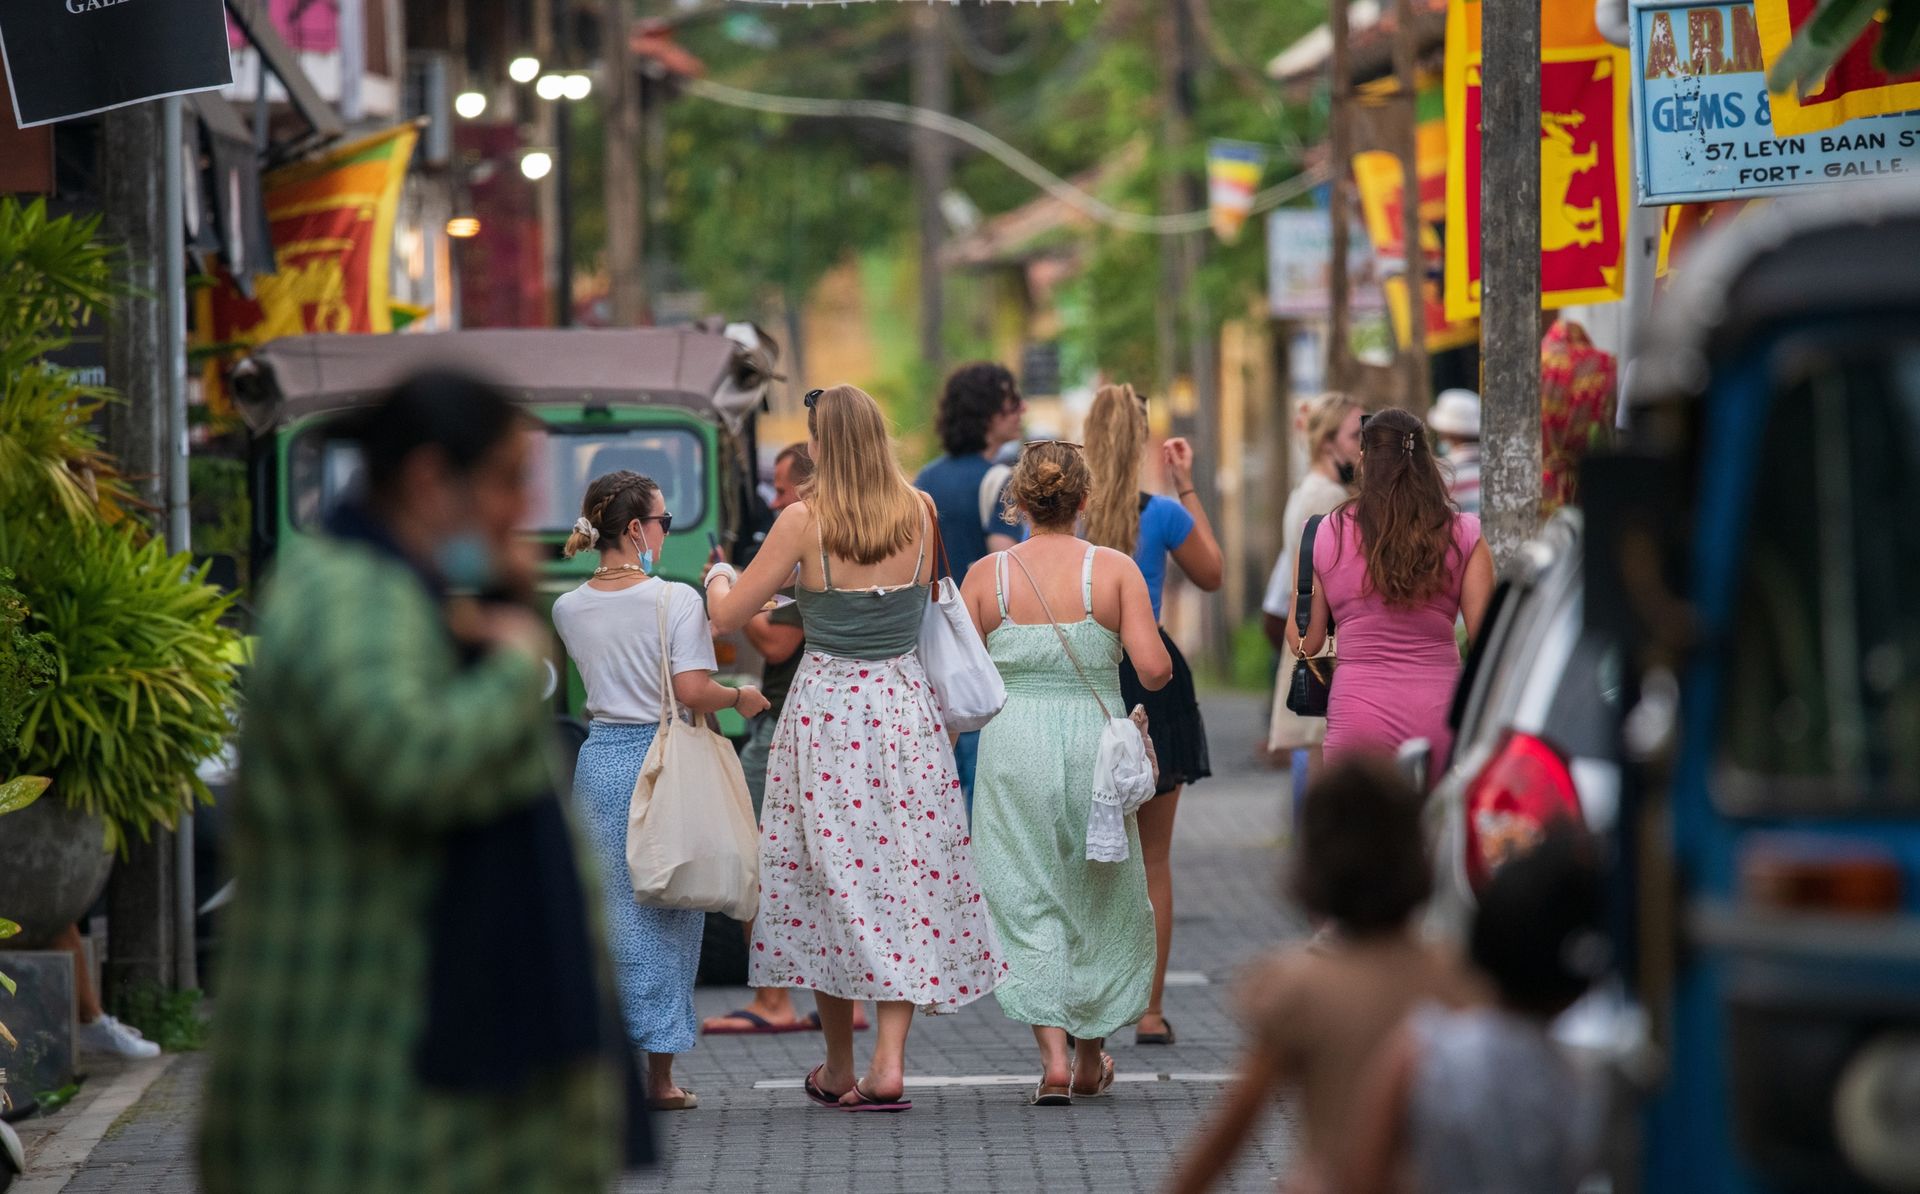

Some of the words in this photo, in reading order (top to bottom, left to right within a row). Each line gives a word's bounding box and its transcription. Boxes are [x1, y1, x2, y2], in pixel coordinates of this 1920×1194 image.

[1652, 92, 1746, 133] GEMS
[1754, 89, 1772, 127] &
[1744, 138, 1805, 158] LEYN
[1820, 132, 1886, 152] BAAN
[1739, 165, 1800, 184] FORT
